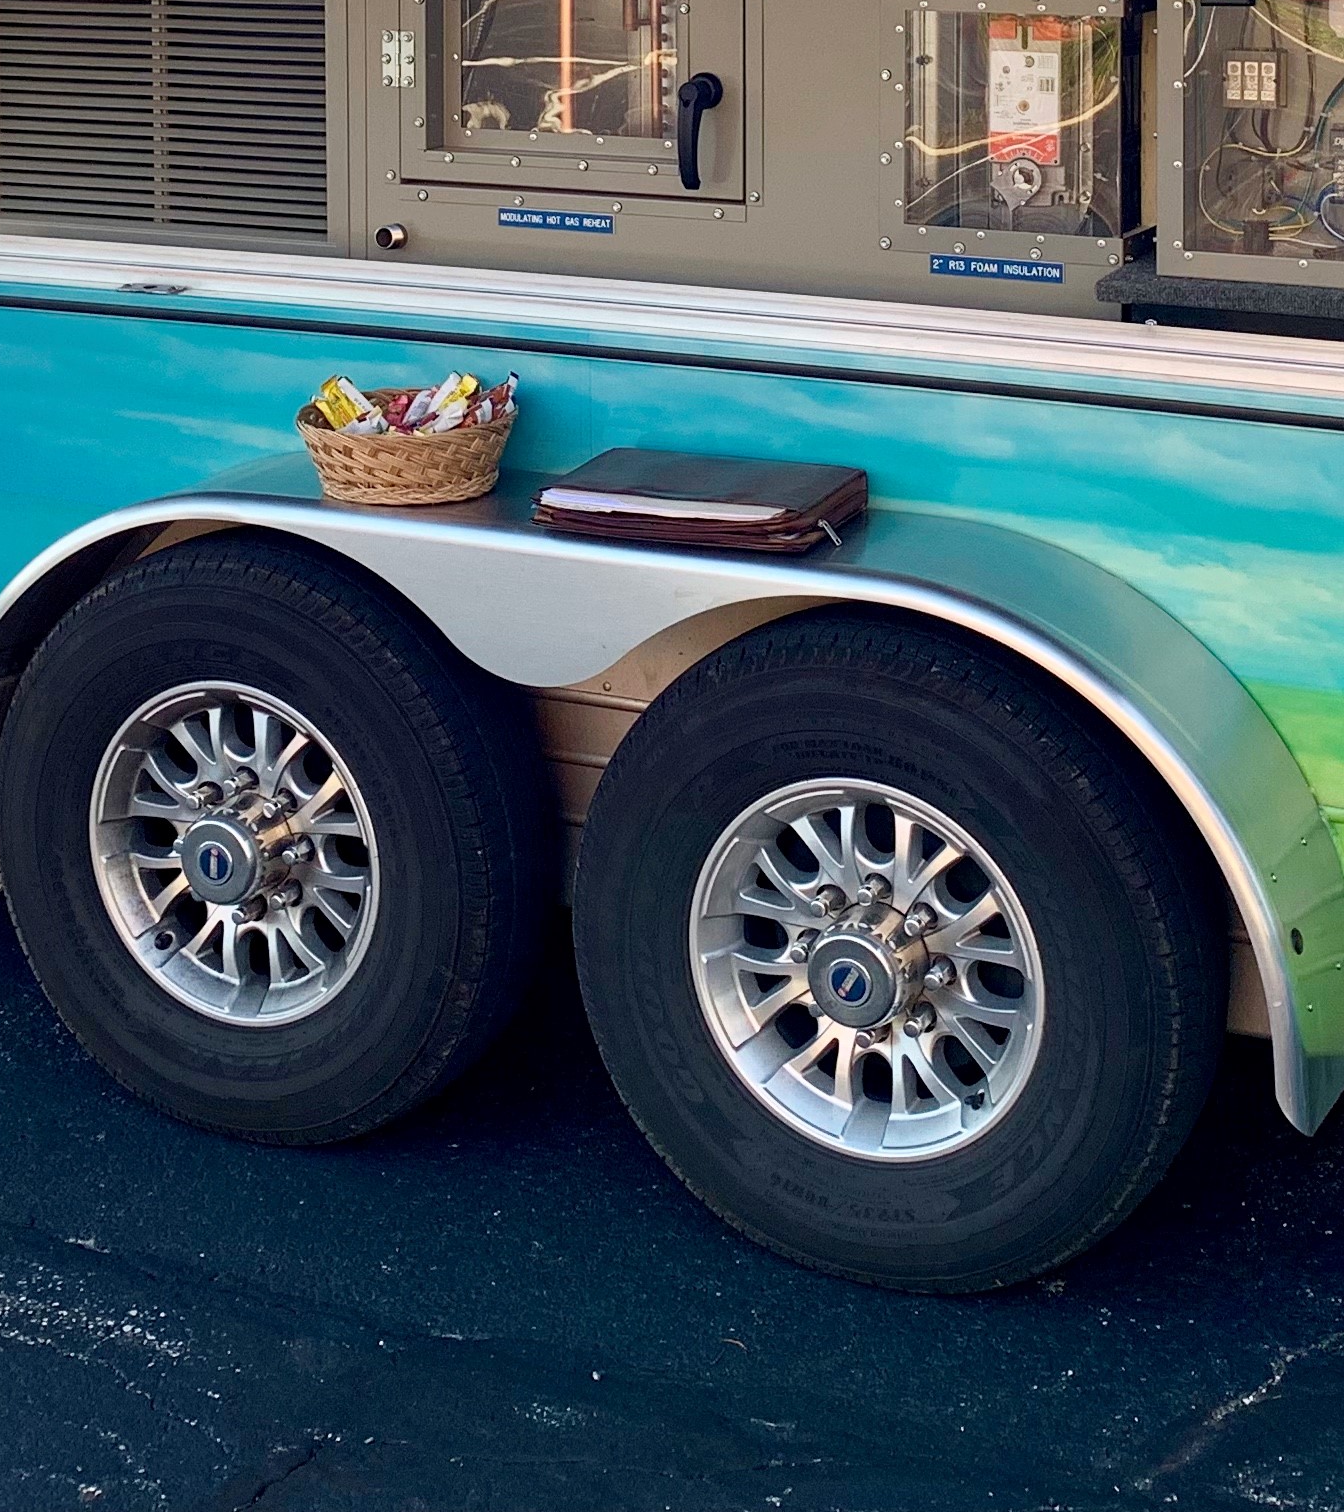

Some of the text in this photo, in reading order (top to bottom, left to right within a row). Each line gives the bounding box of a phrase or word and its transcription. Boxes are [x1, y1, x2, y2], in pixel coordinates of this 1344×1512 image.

[500, 213, 611, 228] MODULATING HOT GAS REHEAT
[949, 260, 965, 271] R13
[971, 262, 998, 273] FOAM
[1004, 264, 1060, 278] INSULATION
